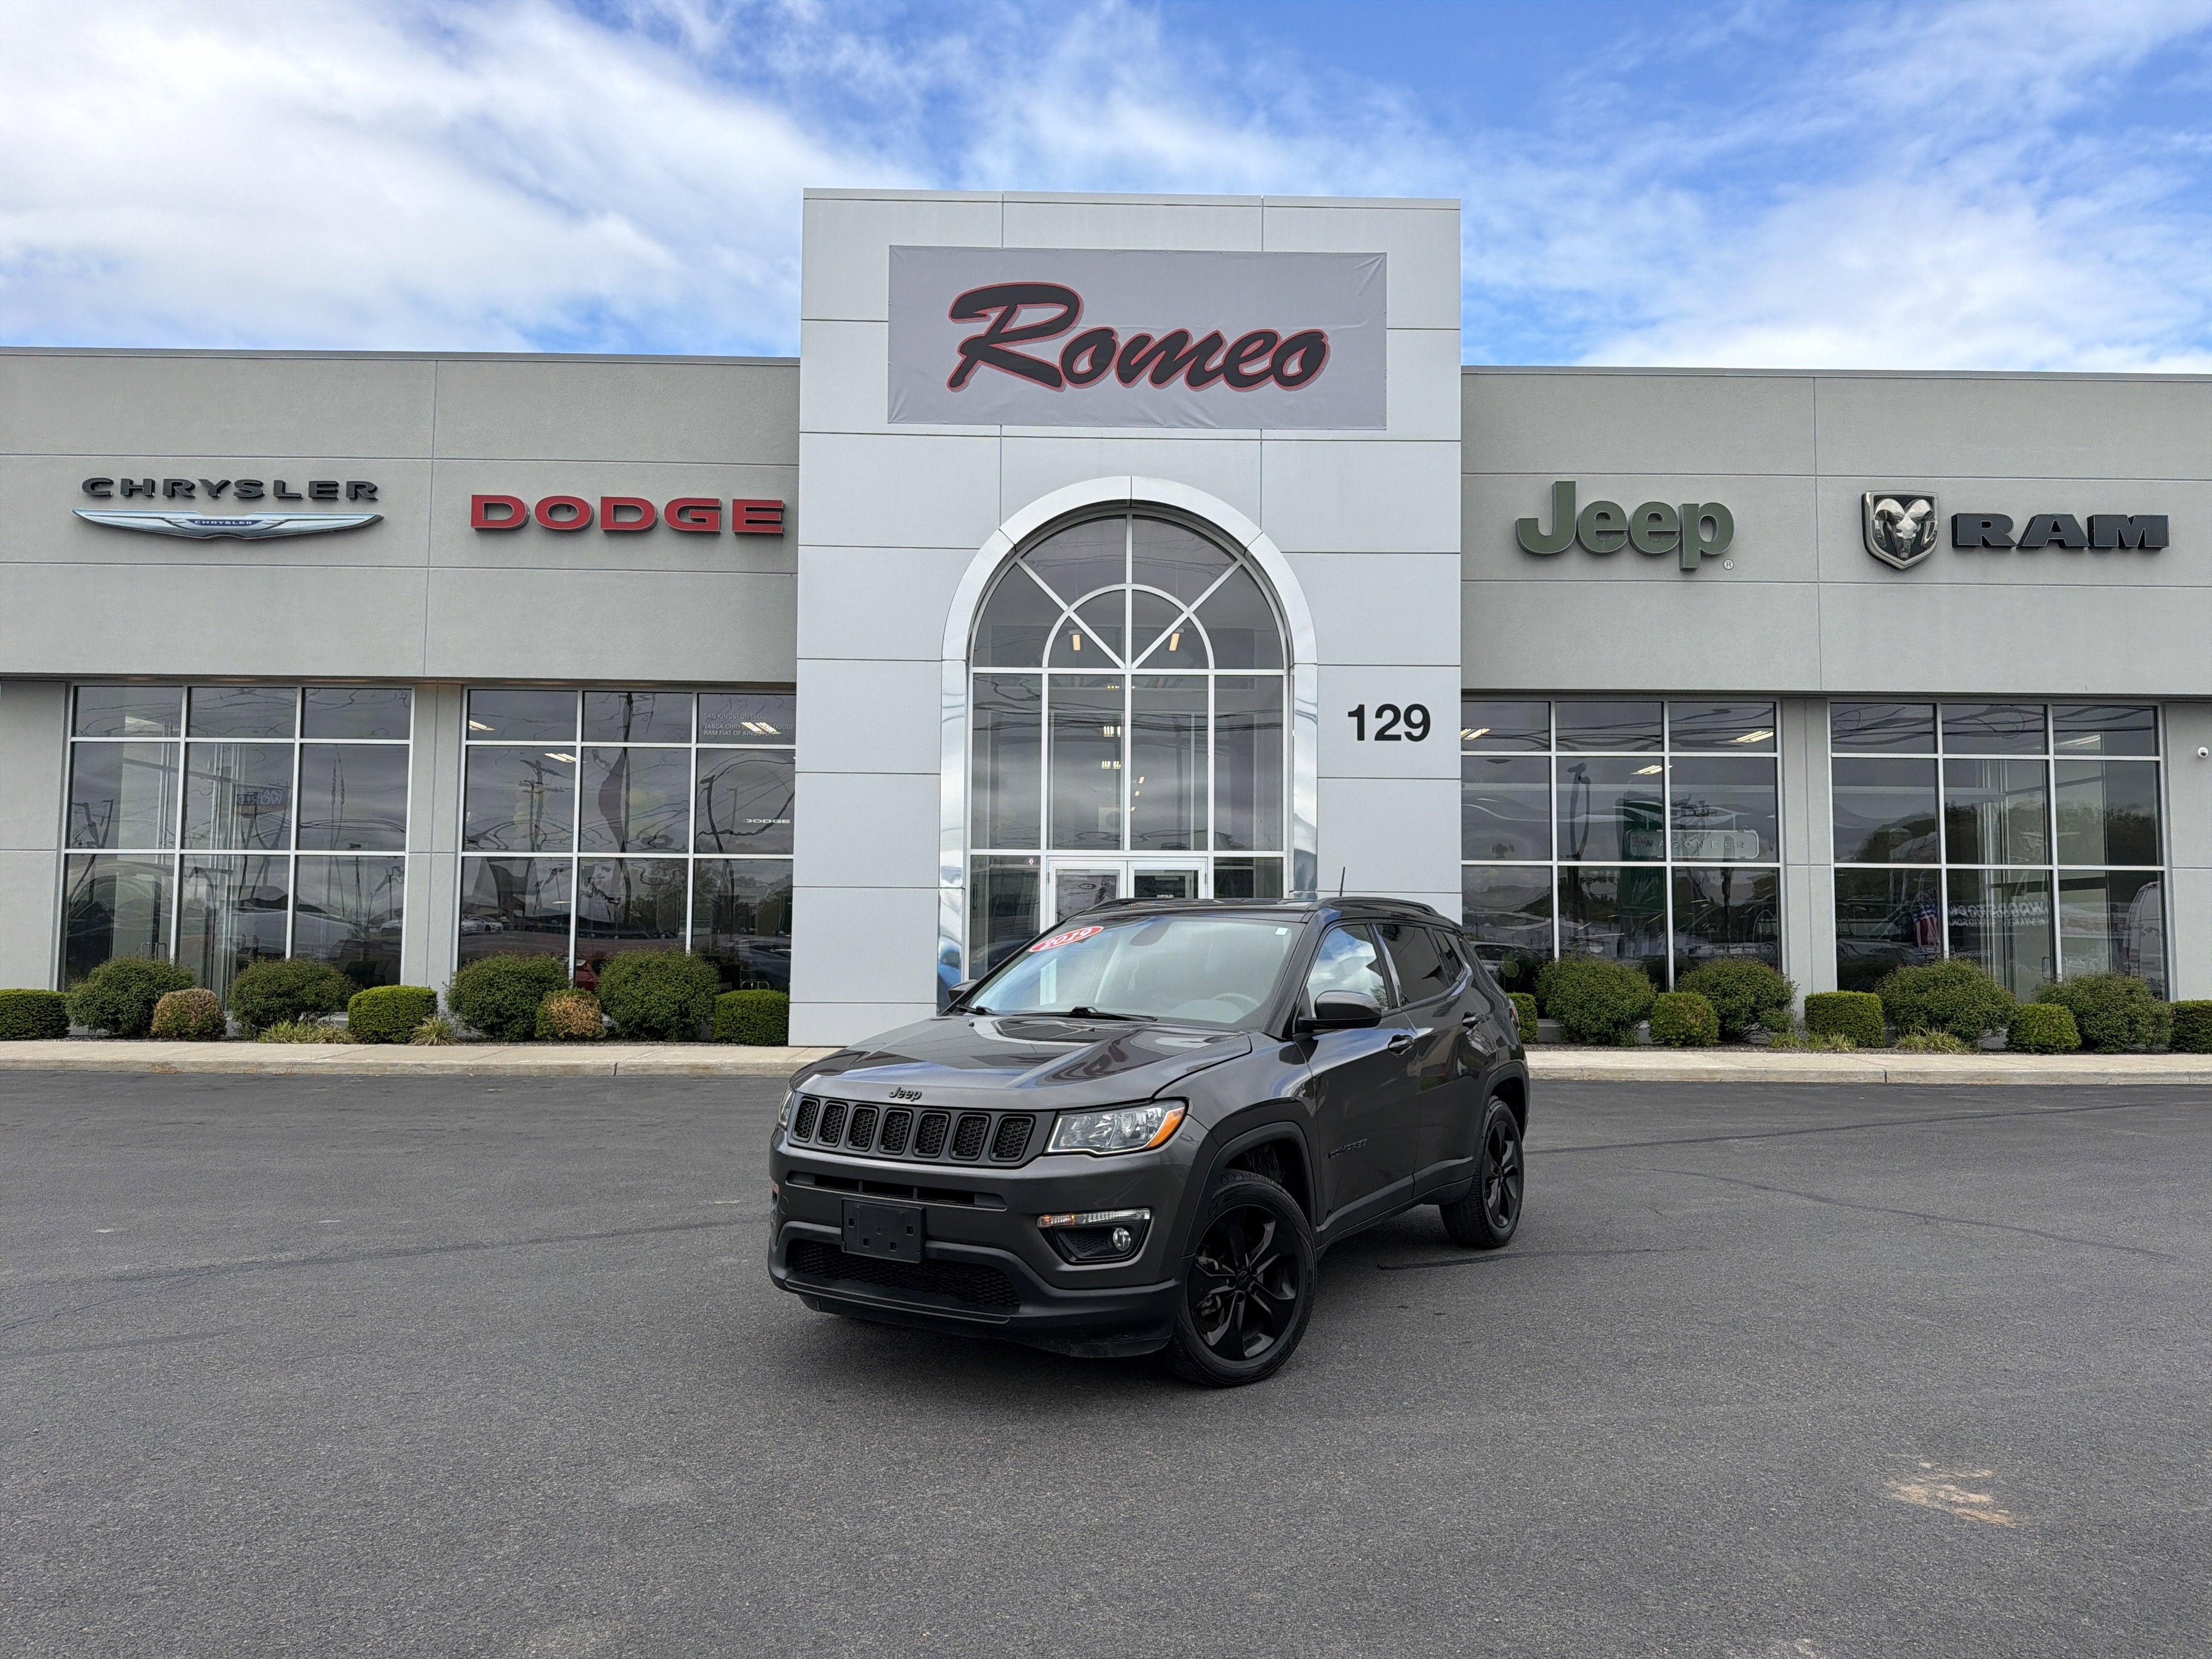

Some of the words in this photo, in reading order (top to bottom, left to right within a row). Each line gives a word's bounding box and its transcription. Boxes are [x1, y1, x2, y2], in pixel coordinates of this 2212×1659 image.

[947, 282, 1329, 392] Romeo
[82, 477, 378, 500] CHRYSLER
[471, 494, 785, 535] DODGE
[1516, 481, 1734, 571] Jeep
[1951, 512, 2170, 550] RAM
[1347, 704, 1431, 742] 129
[1039, 928, 1093, 951] 2019
[888, 1086, 923, 1102] Jeep
